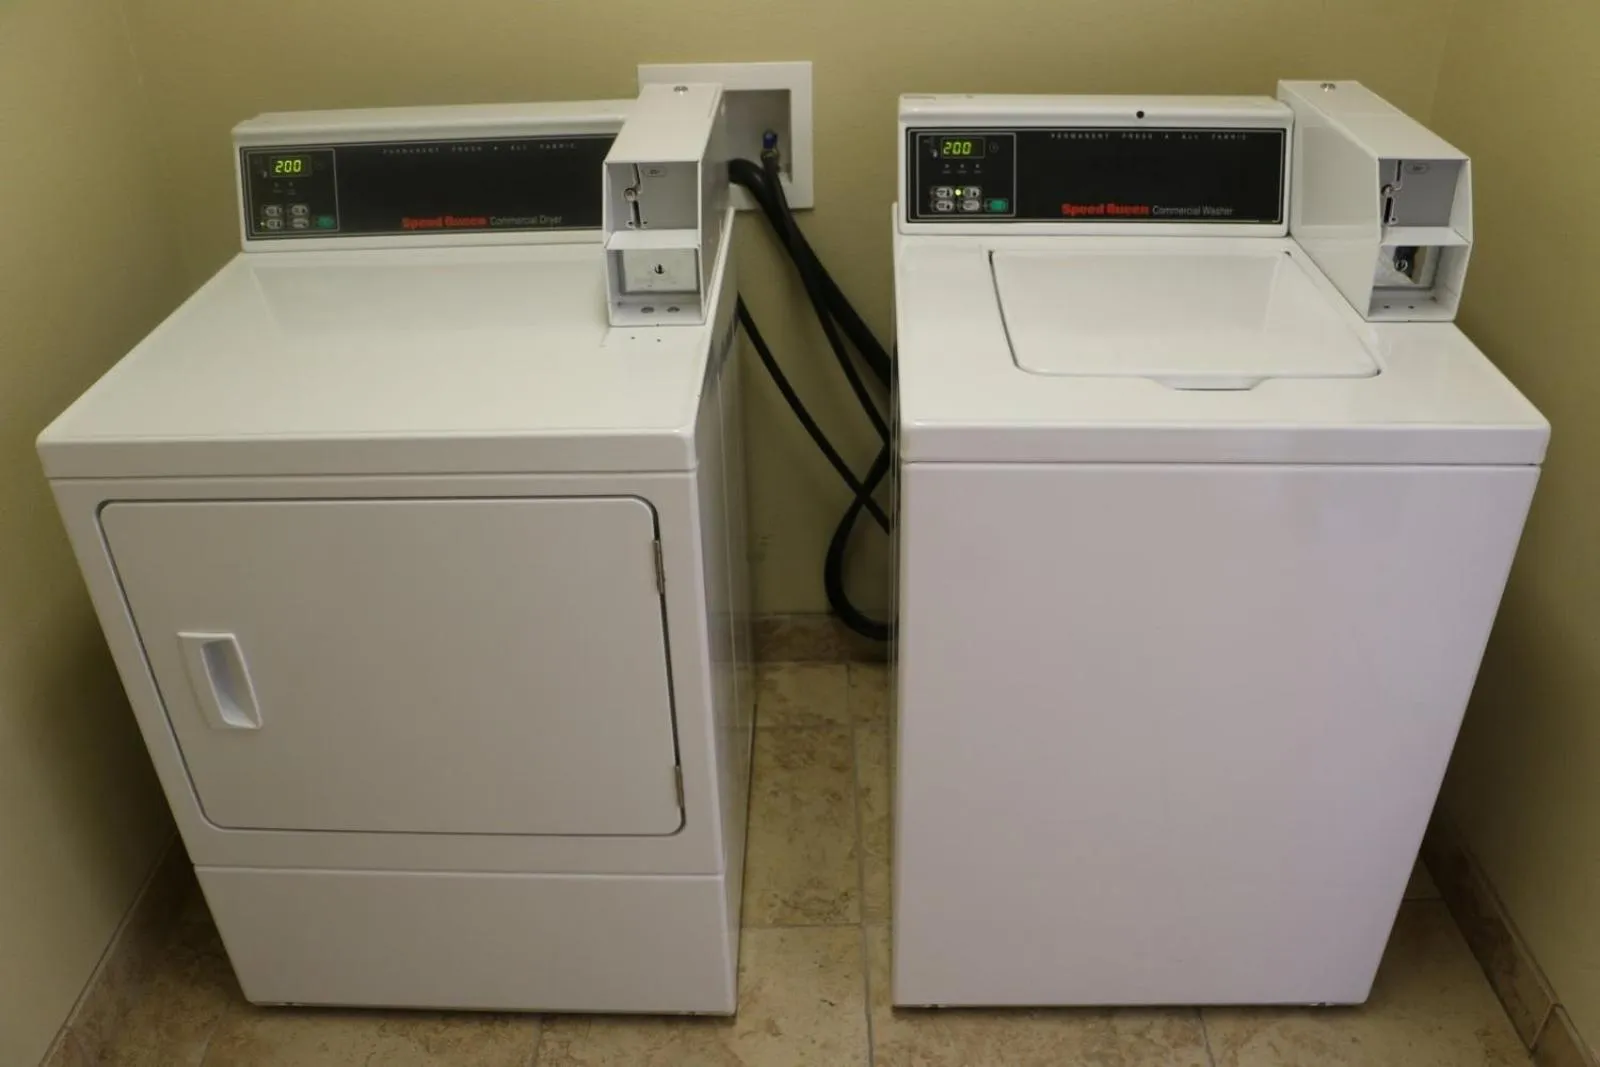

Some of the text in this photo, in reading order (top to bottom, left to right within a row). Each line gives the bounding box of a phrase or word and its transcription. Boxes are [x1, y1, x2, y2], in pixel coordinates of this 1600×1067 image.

[943, 141, 972, 155] 200
[275, 159, 302, 173] 200
[1062, 203, 1234, 217] Speed Queen Commercial Washer
[402, 215, 562, 229] Speed Queen Commercial Dryer
